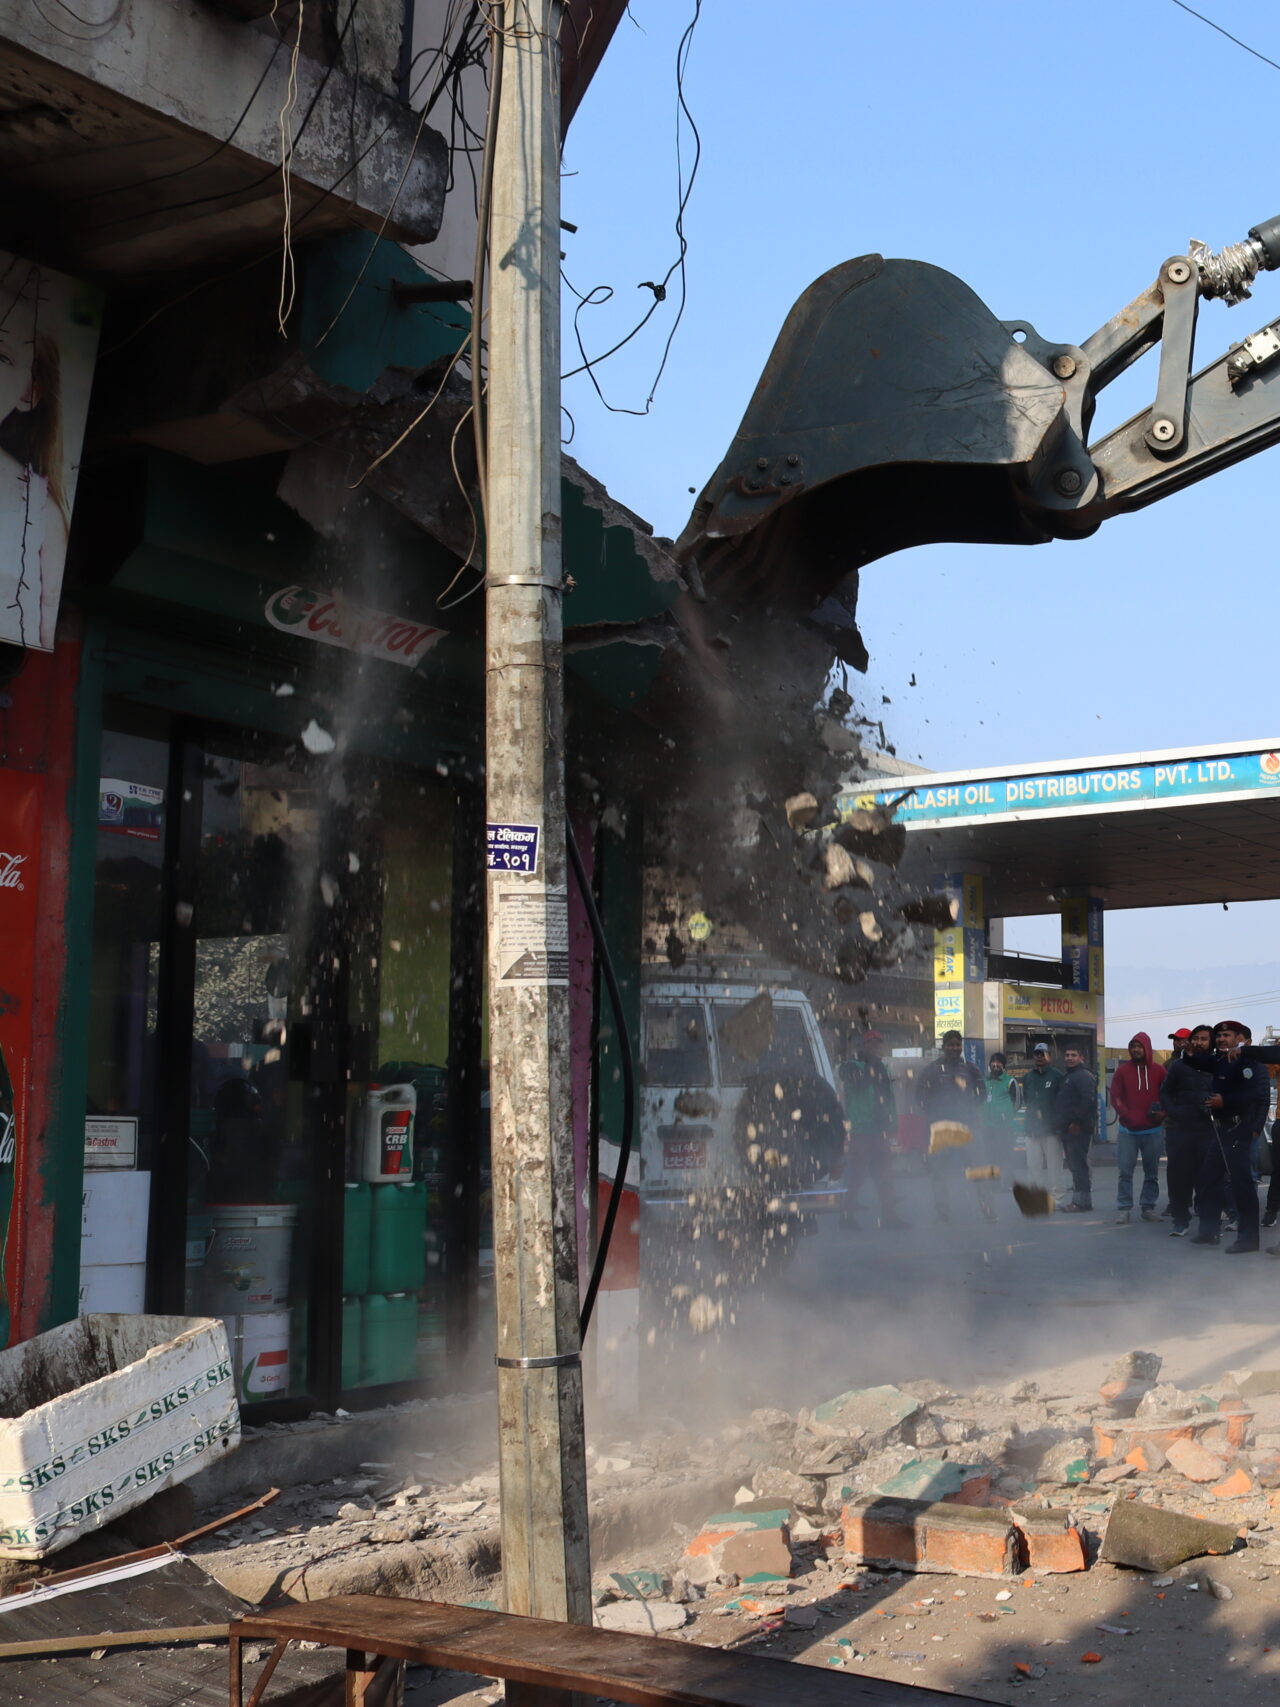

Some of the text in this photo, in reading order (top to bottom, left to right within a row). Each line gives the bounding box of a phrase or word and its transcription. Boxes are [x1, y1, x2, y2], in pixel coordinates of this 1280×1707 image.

[965, 785, 995, 805] OIL
[1006, 770, 1141, 801] DISTRIBUTORS
[1155, 766, 1192, 787] PVT.
[1198, 761, 1235, 782] LTD.
[497, 828, 535, 842] टेलिकम
[937, 996, 960, 1008] कार
[1040, 997, 1075, 1014] PETROL
[92, 1138, 117, 1147] Castrol
[386, 1135, 408, 1144] CRB
[19, 1360, 232, 1492] SKS SKS SKS SK
[71, 1484, 115, 1521] SKS
[135, 1451, 175, 1487] SKS
[194, 1419, 230, 1454] SKS
